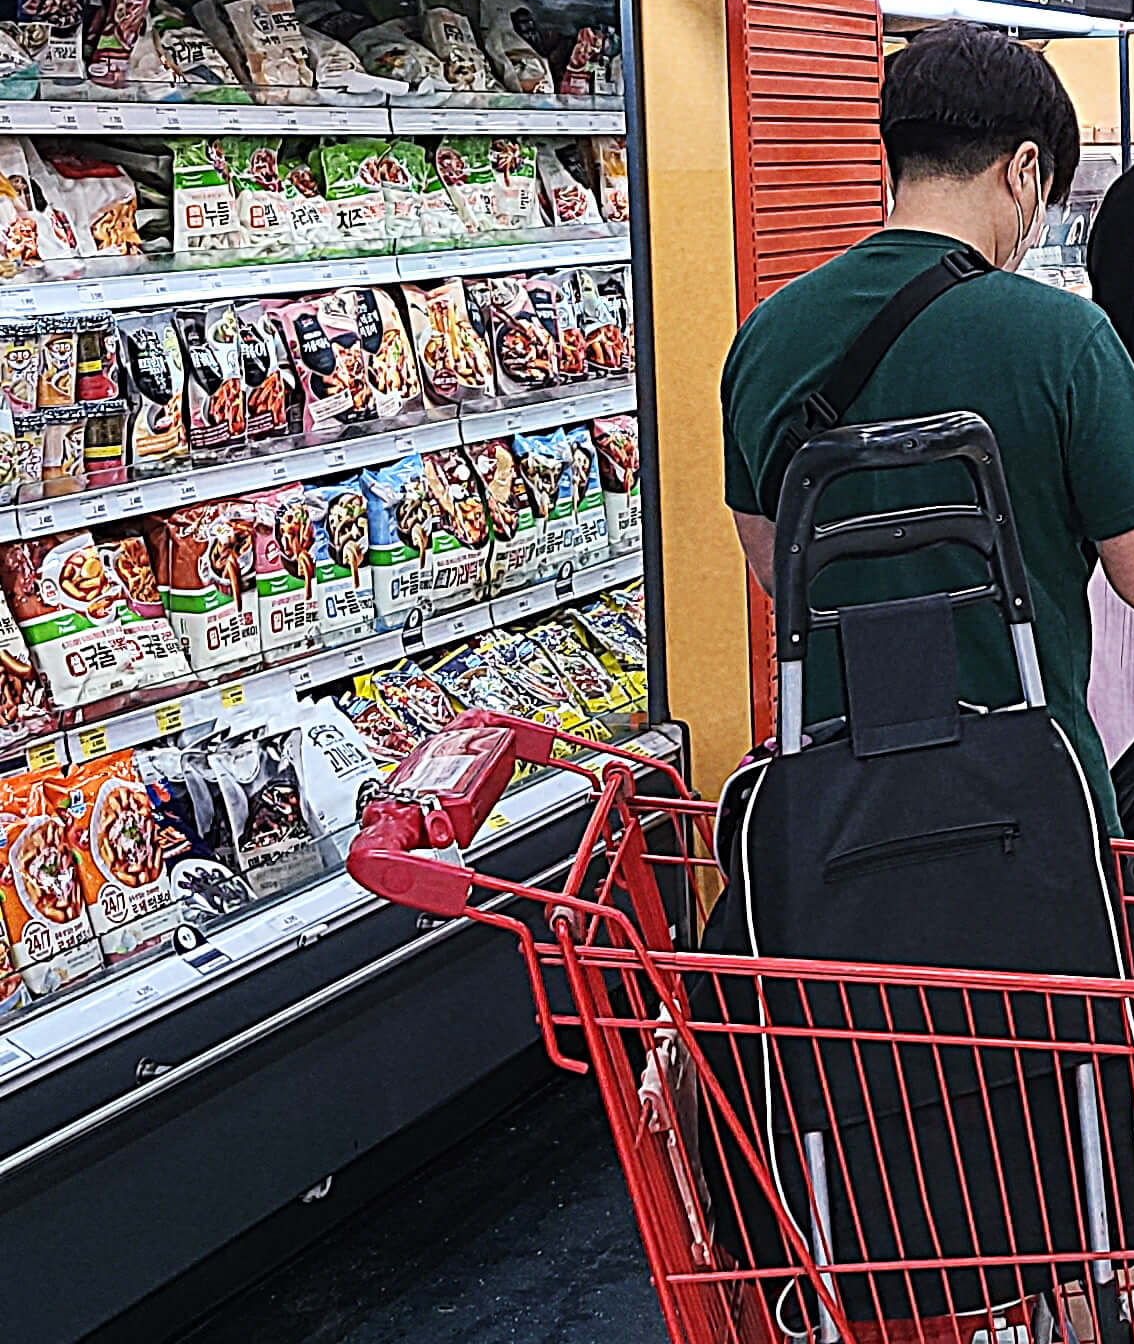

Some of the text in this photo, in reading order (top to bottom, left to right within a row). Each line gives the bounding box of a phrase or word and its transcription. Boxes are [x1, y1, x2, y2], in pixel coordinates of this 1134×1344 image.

[203, 201, 230, 228] 누들
[336, 207, 367, 230] 치즈
[400, 570, 419, 599] 누들
[283, 601, 305, 631] 누들
[334, 590, 361, 618] 누들
[101, 892, 127, 917] 24/7
[25, 929, 52, 955] 24/7
